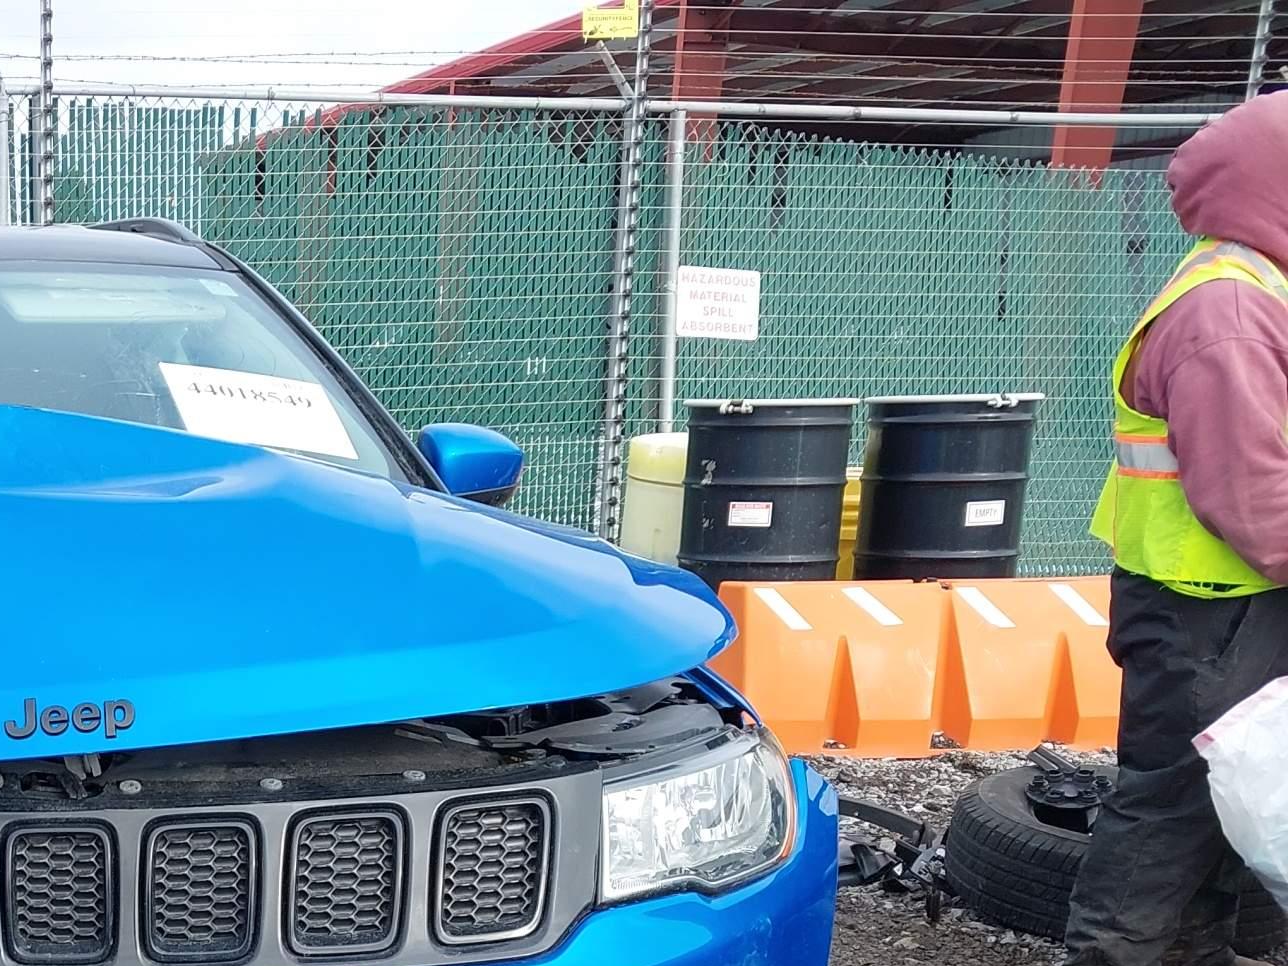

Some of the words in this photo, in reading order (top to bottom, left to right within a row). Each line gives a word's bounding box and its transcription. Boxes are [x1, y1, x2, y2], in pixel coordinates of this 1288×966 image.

[681, 272, 756, 288] HAZARDOUS
[689, 290, 748, 303] MATERIAL
[703, 306, 734, 318] SPILL
[681, 320, 753, 334] ABSORBENT
[187, 382, 312, 408] 44018549
[975, 508, 998, 518] EMPTY
[4, 698, 136, 739] Jeep
